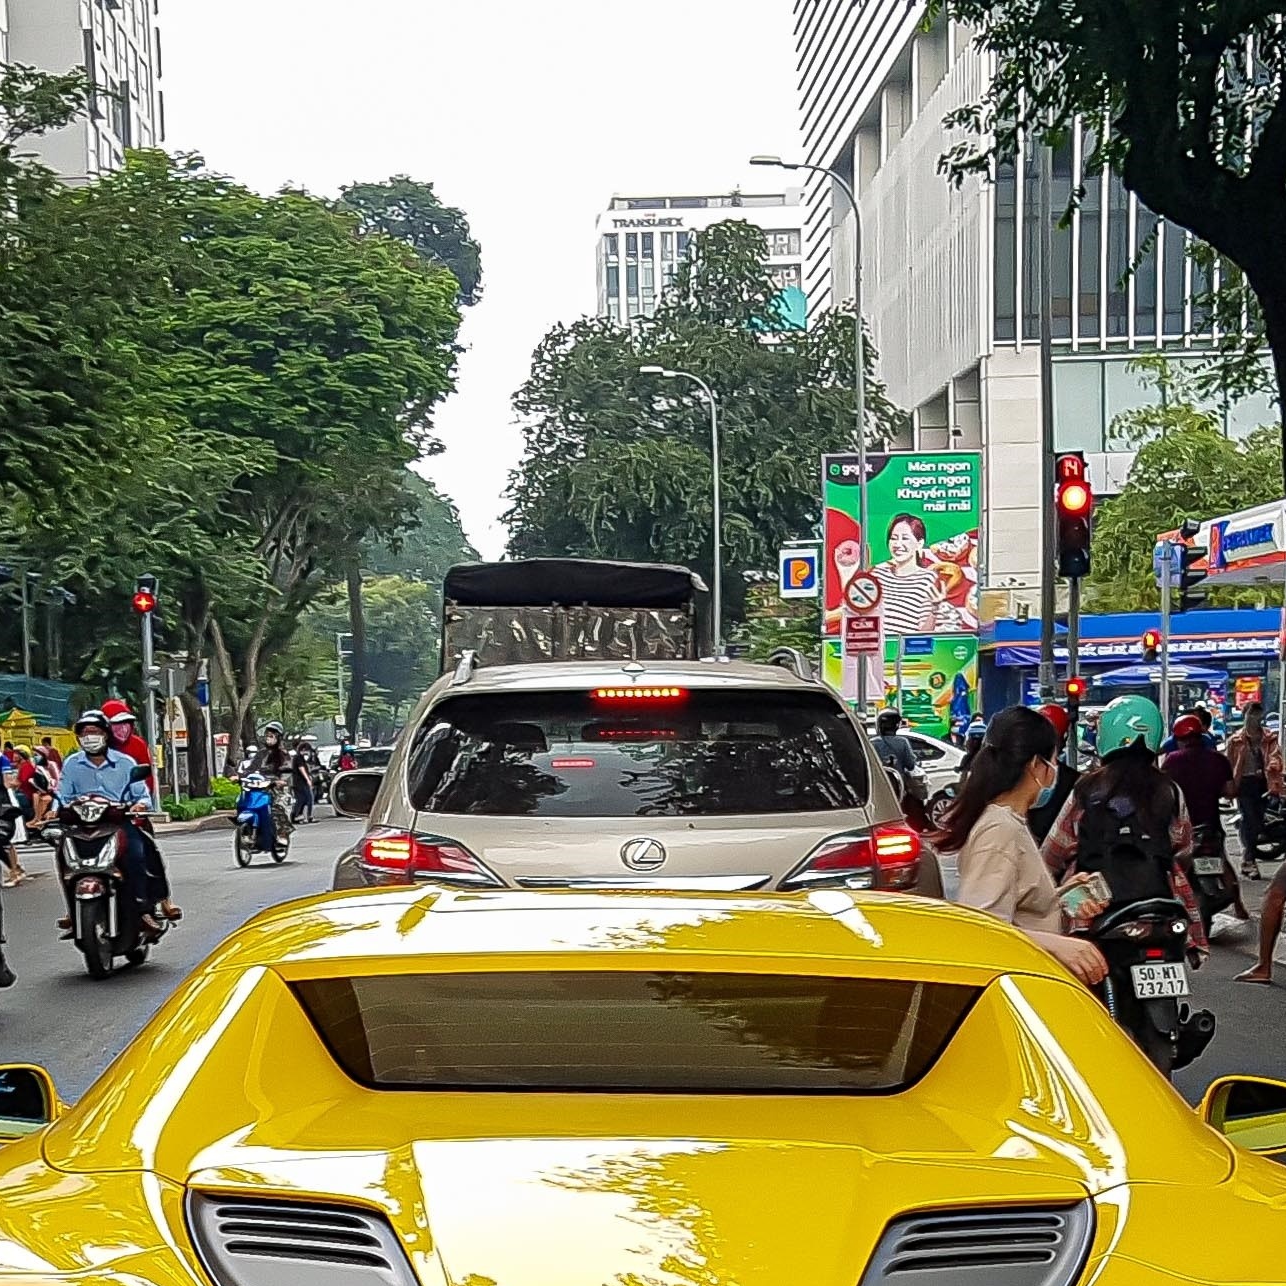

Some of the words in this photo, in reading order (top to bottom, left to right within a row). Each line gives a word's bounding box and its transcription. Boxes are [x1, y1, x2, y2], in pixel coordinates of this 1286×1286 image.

[937, 462, 971, 474] ngon
[903, 476, 936, 487] ngon
[937, 475, 971, 487] ngon
[1137, 980, 1185, 996] 232.17
